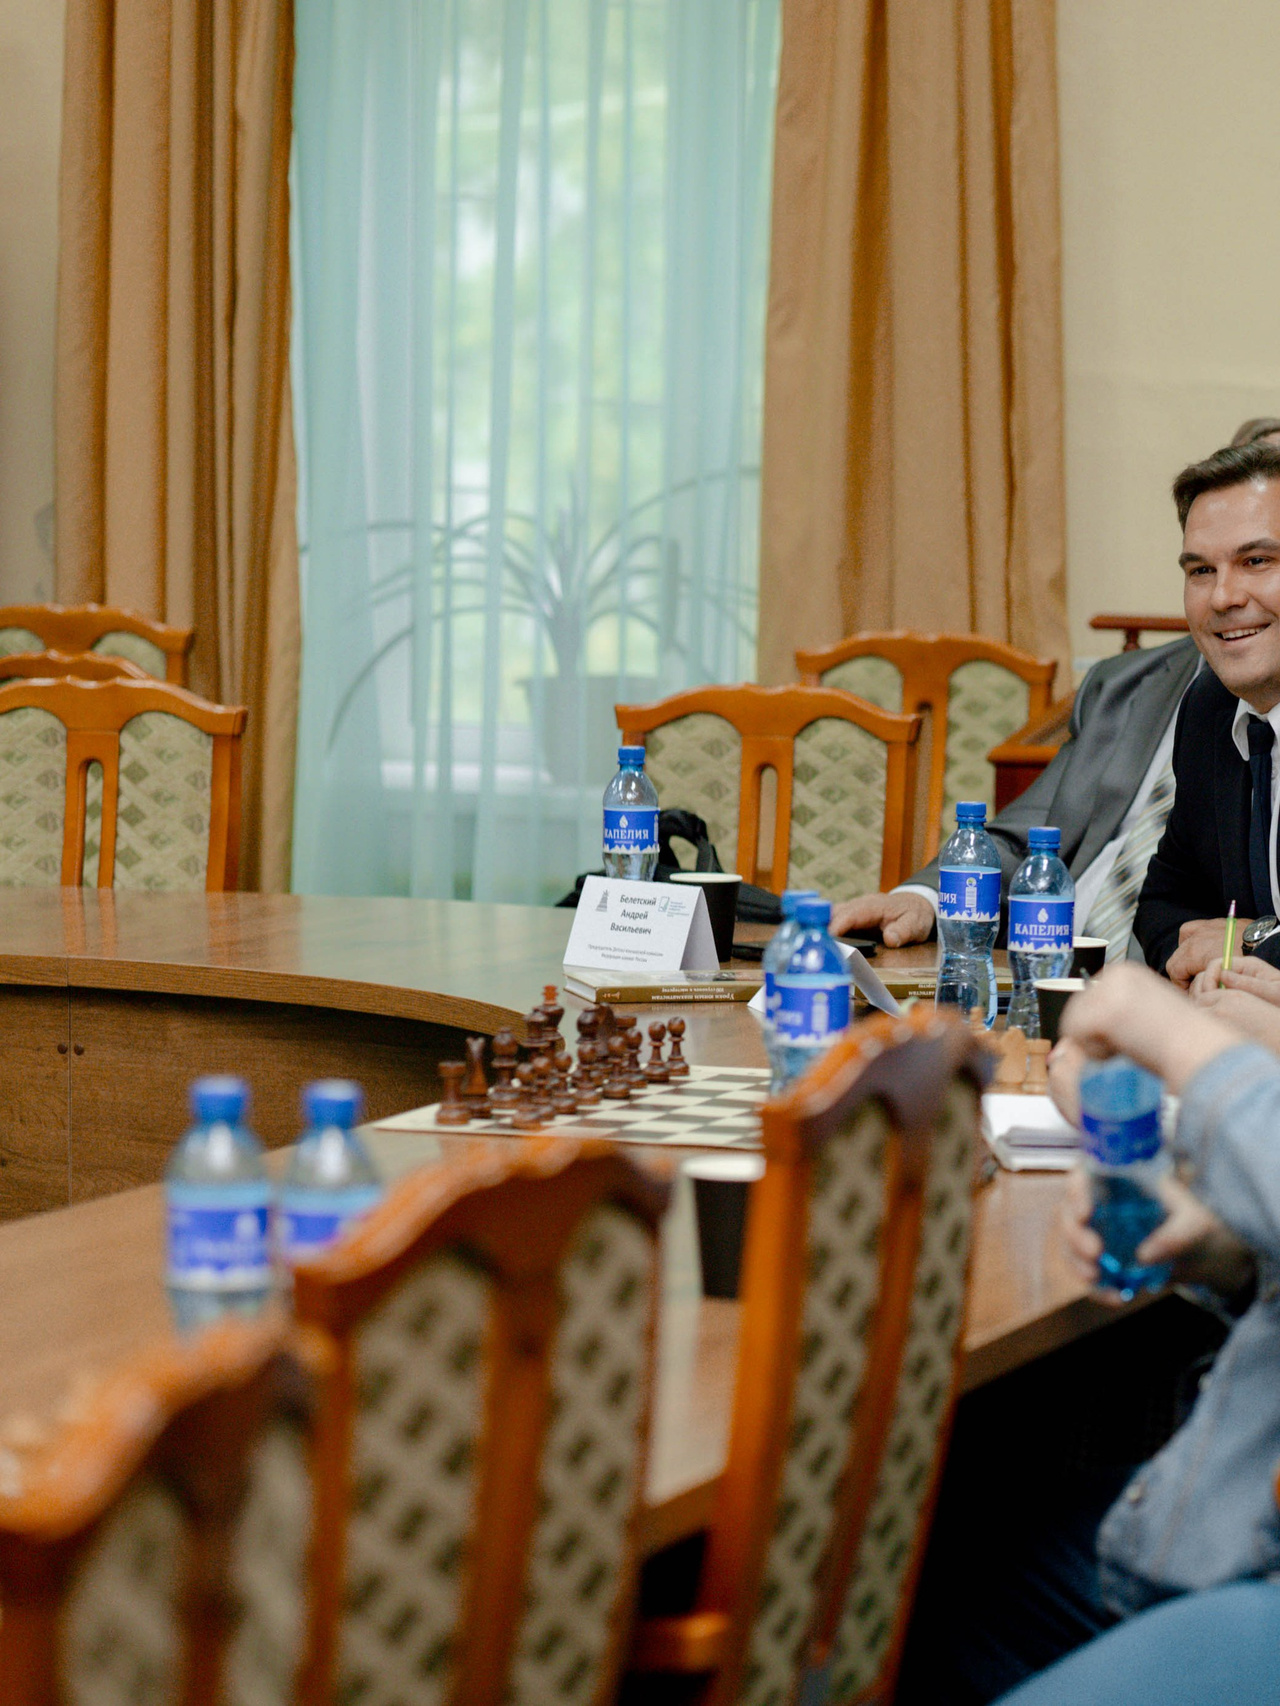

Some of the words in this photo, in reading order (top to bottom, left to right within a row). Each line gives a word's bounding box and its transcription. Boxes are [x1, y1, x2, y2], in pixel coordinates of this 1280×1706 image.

[620, 894, 657, 906] Белетский
[620, 908, 649, 920] Андрей
[610, 922, 652, 935] Васильевич
[1014, 922, 1070, 936] КАПЕЛИЯ
